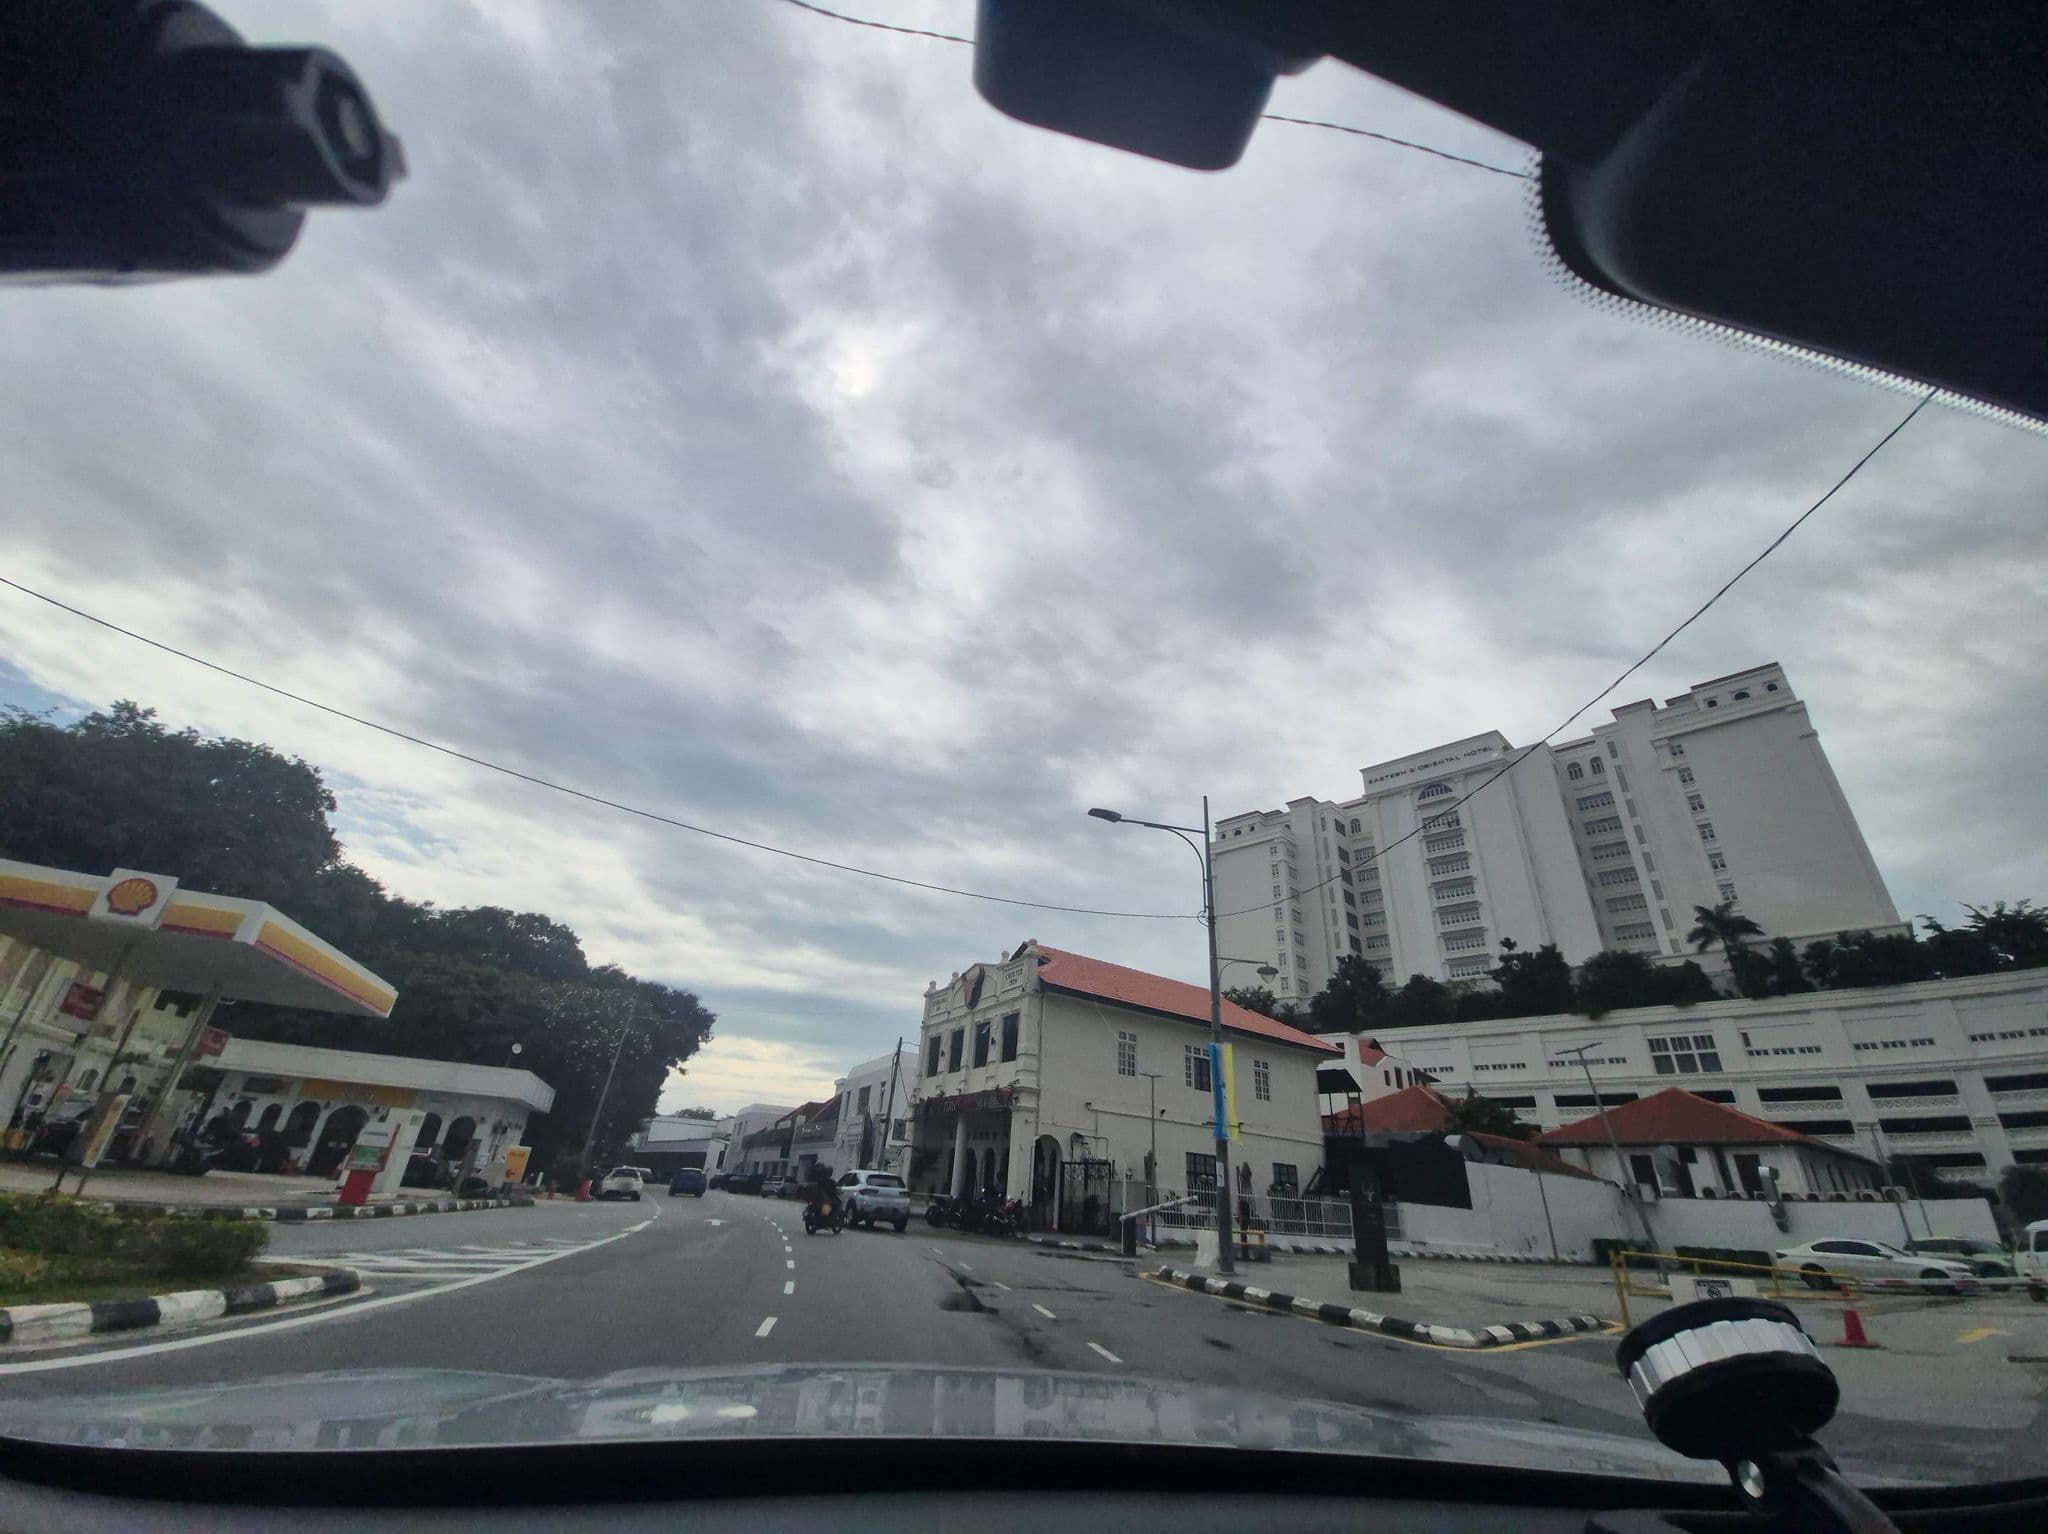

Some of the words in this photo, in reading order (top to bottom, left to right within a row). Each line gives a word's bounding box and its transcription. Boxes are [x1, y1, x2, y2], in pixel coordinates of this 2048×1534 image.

[1368, 770, 1407, 784] EASTERN
[1417, 756, 1461, 771] ORIENTAL
[1463, 745, 1494, 757] HOTEL
